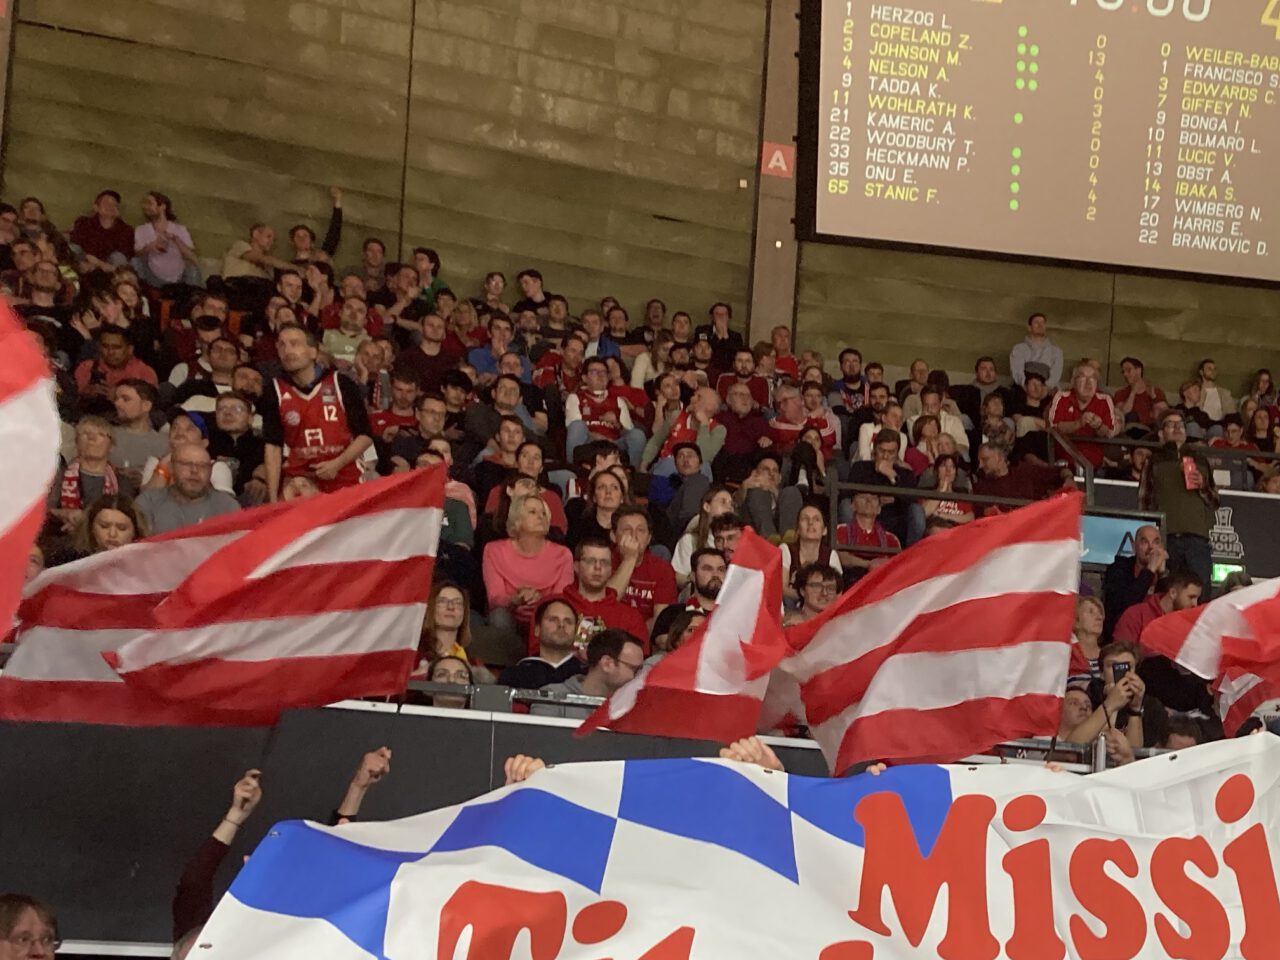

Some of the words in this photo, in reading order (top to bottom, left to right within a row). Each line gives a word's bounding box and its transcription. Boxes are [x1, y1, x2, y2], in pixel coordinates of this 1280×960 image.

[846, 1, 852, 16] 1
[870, 4, 934, 27] HERZOG
[1097, 34, 1107, 49] 0
[843, 19, 854, 34] 2
[870, 22, 951, 46] COPELAND
[1088, 50, 1105, 66] 13
[1161, 42, 1171, 57] 0
[843, 37, 853, 52] 3
[869, 41, 939, 63] JOHNSON
[1095, 69, 1104, 84] 4
[1162, 59, 1167, 74] 1
[1184, 62, 1263, 86] FRANCISCO
[842, 55, 852, 70] 4
[868, 58, 928, 79] NELSON
[1094, 86, 1104, 101] 0
[1158, 77, 1168, 92] 3
[1183, 80, 1258, 101] EDWARDS
[842, 73, 852, 88] 9
[868, 76, 921, 96] TADDA
[1093, 103, 1103, 118] 3
[1158, 94, 1168, 108] 7
[1181, 97, 1233, 116] GIFFEY
[833, 89, 849, 105] 11
[868, 94, 957, 118] WOHLRATH
[1091, 120, 1102, 135] 2
[1156, 111, 1166, 125] 9
[1180, 113, 1228, 132] BONGA
[830, 108, 849, 123] 21
[867, 111, 935, 133] KAMERIC
[1091, 137, 1100, 152] 0
[1148, 127, 1165, 142] 10
[1179, 130, 1245, 152] BOLMARO
[829, 125, 851, 141] 22
[867, 128, 956, 153] WOODBURY
[1089, 154, 1099, 169] 0
[1147, 143, 1161, 159] 11
[1178, 147, 1216, 164] LUCIC
[768, 149, 787, 171] A
[829, 143, 850, 159] 33
[865, 147, 950, 170] HECKMANN
[1089, 171, 1098, 186] 4
[1146, 161, 1163, 176] 13
[1177, 164, 1214, 181] OBST
[828, 161, 849, 177] 35
[865, 165, 896, 182] ONU
[1087, 188, 1097, 204] 4
[1145, 177, 1161, 193] 14
[1175, 181, 1217, 199] IBAKA
[828, 179, 849, 195] 65
[864, 182, 919, 202] STANIC
[1086, 206, 1096, 221] 2
[1143, 195, 1160, 210] 17
[1175, 198, 1244, 219] WIMBERG
[1140, 212, 1159, 227] 20
[1173, 215, 1224, 234] HARRIS
[1139, 229, 1158, 244] 22
[1172, 232, 1251, 254] BRANKOVIC
[323, 405, 338, 421] 12
[1212, 532, 1236, 542] TOP
